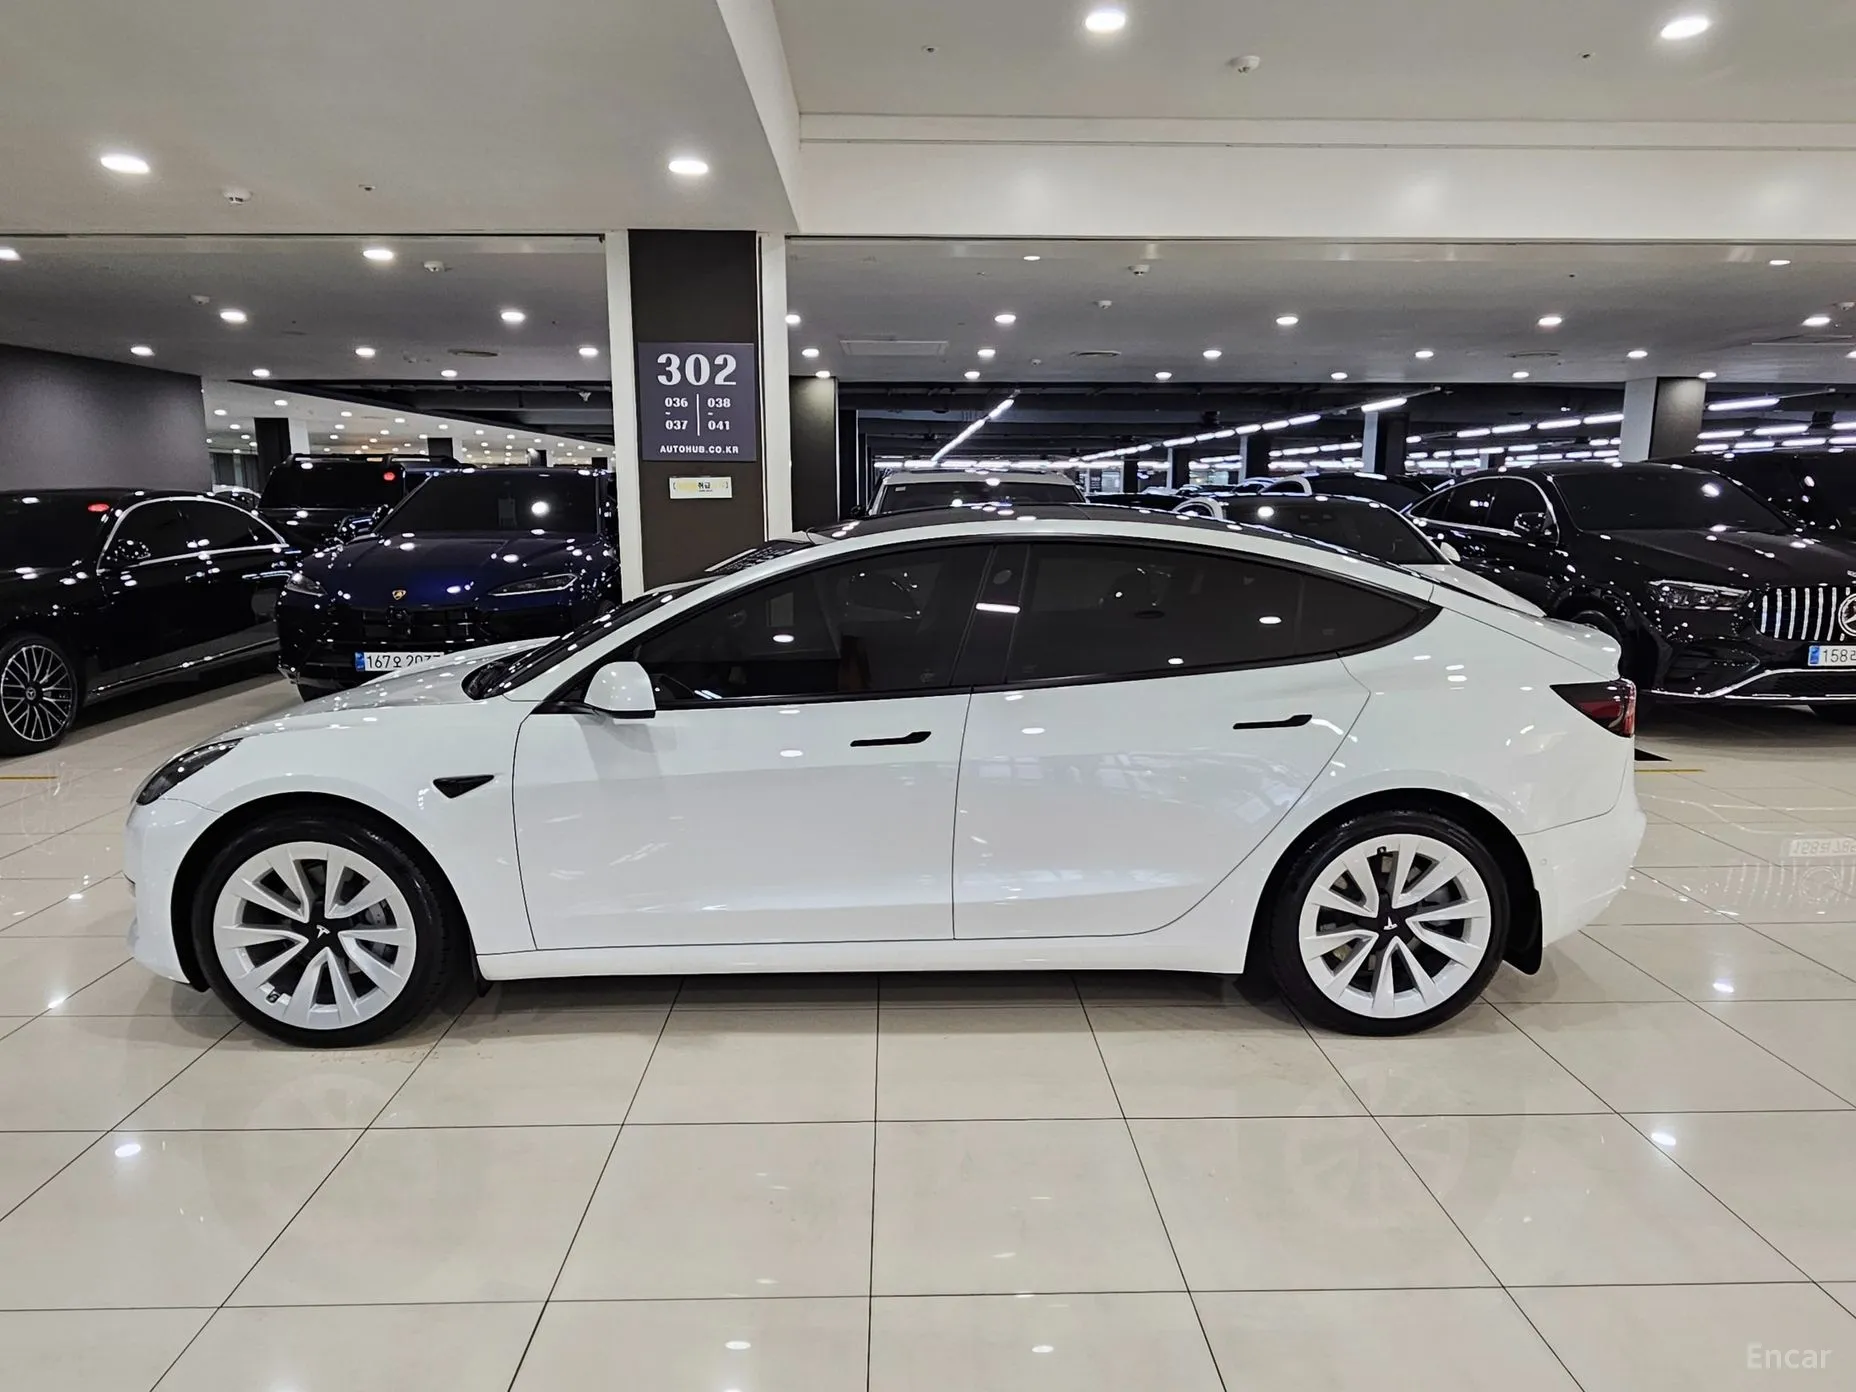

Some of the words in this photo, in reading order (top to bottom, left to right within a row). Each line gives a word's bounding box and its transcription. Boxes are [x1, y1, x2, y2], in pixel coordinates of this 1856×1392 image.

[657, 353, 737, 386] 302
[664, 397, 689, 408] 036
[707, 397, 731, 408] 038
[665, 420, 688, 430] 037
[708, 420, 730, 430] 041
[660, 445, 739, 454] AUTOHUB.CO.KR
[367, 655, 402, 668] 167오
